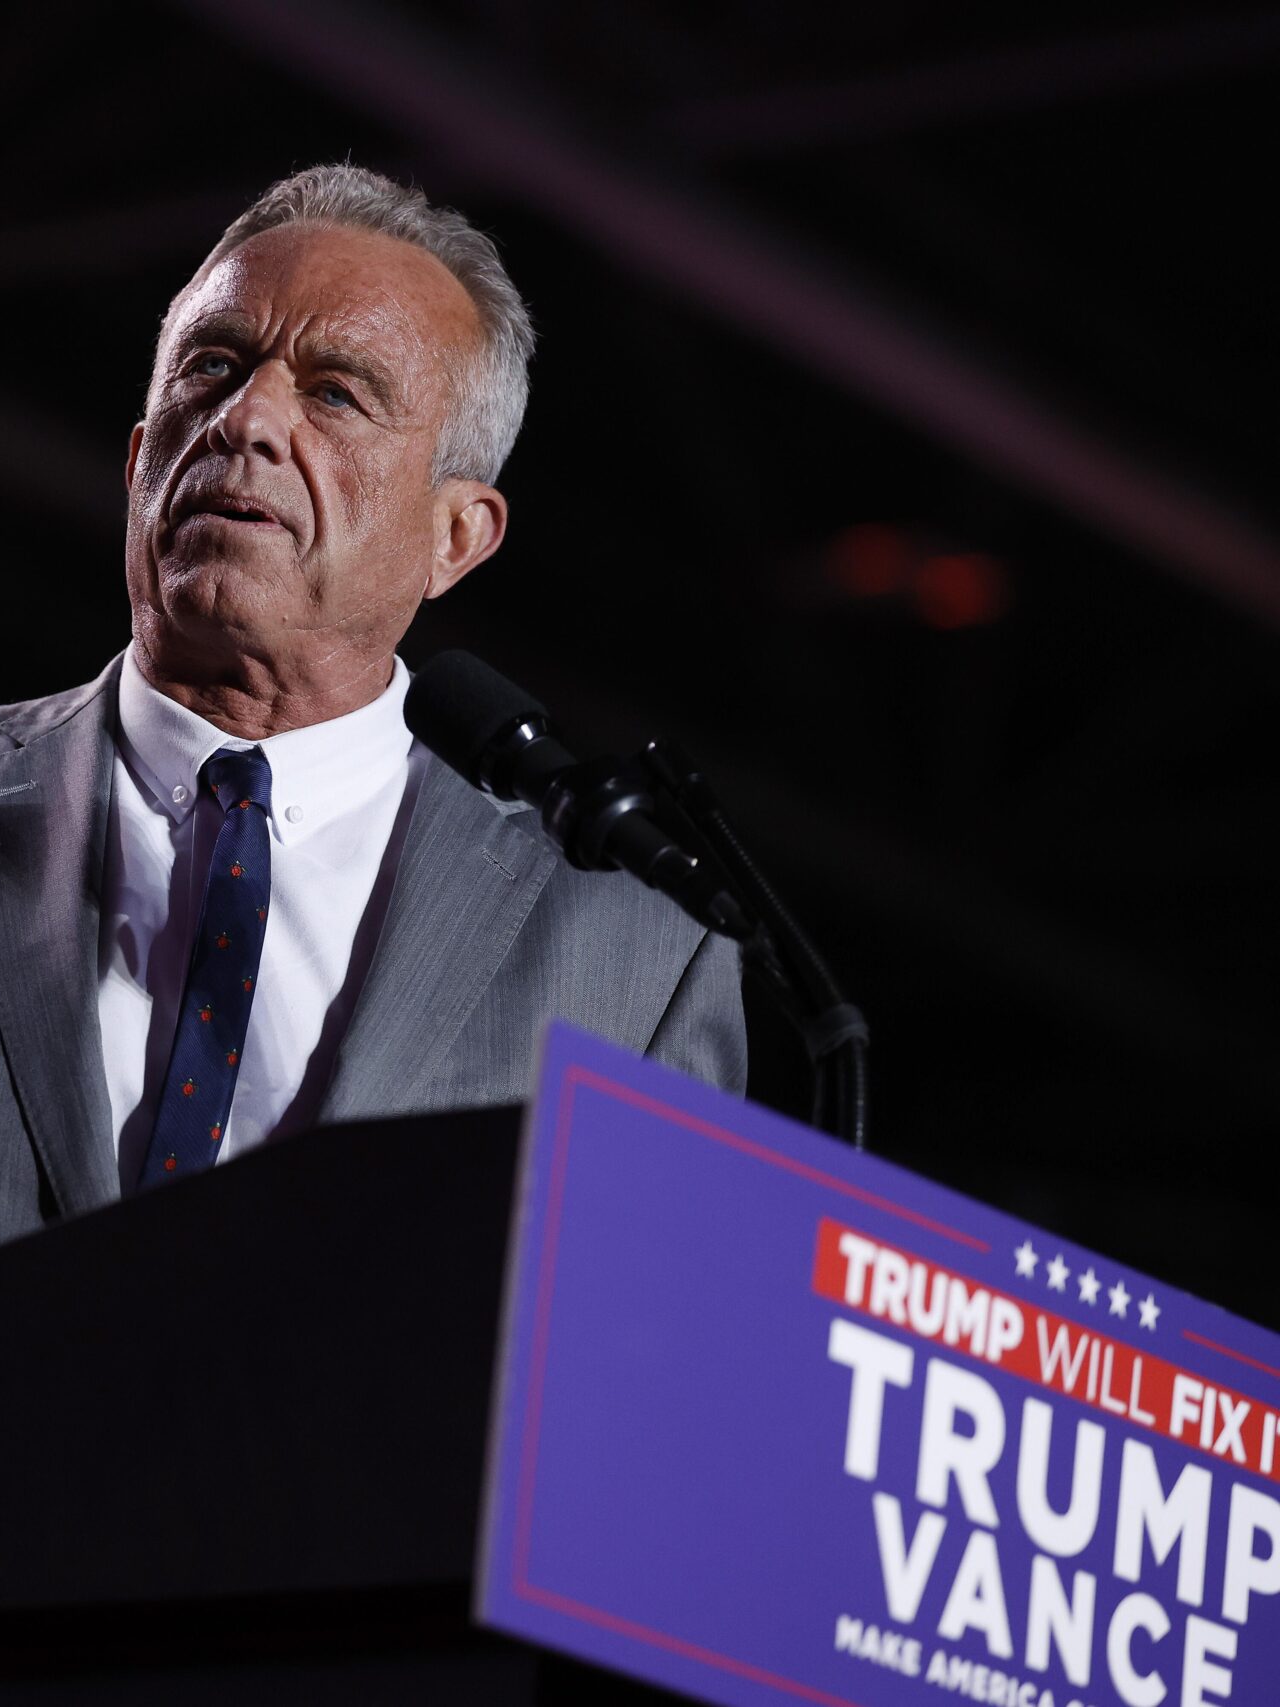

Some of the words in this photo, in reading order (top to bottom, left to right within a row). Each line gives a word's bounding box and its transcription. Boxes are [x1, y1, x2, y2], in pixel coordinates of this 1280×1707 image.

[838, 1231, 1024, 1363] TRUMP
[1036, 1315, 1156, 1427] WILL
[1169, 1373, 1252, 1464] FIX
[1259, 1411, 1280, 1475] I
[827, 1318, 1280, 1625] TRUMP
[834, 1614, 922, 1678] MAKE
[872, 1492, 1239, 1707] VANCE
